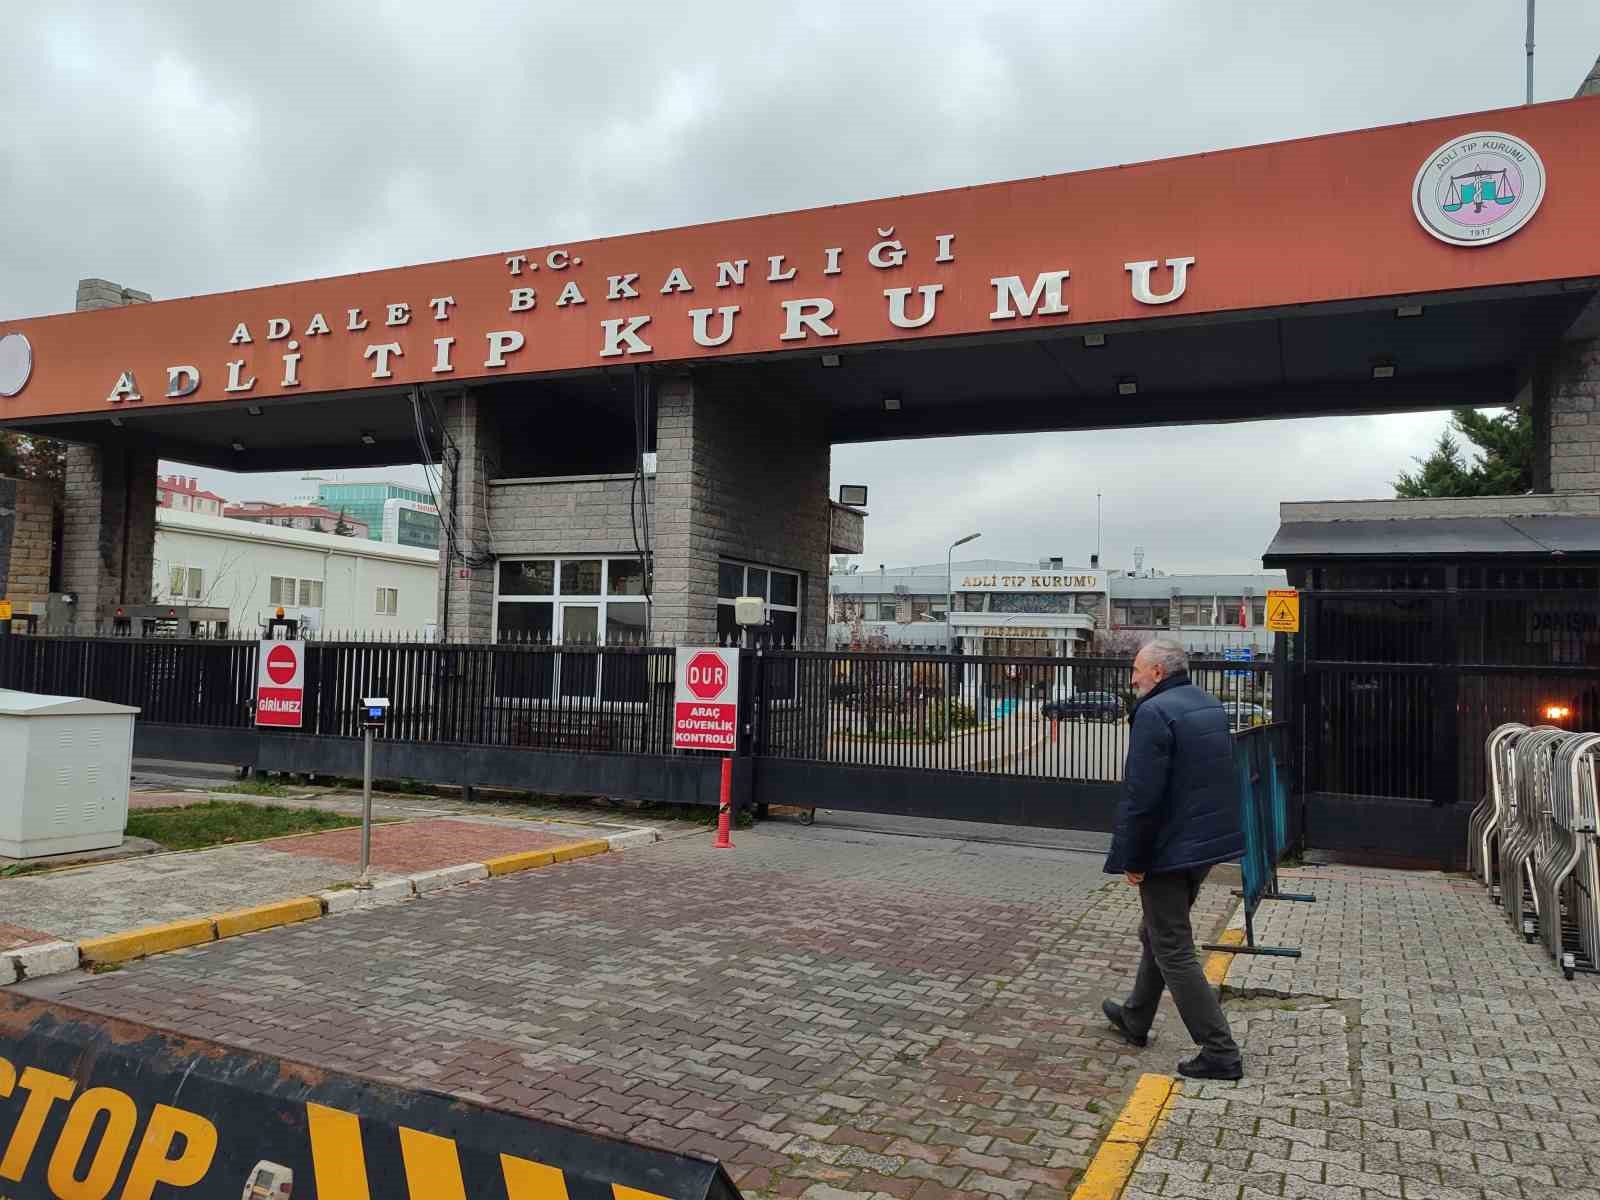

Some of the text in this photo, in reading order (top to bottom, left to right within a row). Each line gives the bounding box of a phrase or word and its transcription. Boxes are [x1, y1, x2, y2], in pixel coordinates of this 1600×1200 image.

[1461, 142, 1478, 153] TIP
[1482, 141, 1526, 163] KURUMU
[506, 248, 582, 276] T.C.
[229, 226, 956, 344] ADALET BAKANLIĞI
[106, 256, 1197, 403] ADLİ TIP KURUMU
[962, 573, 1096, 588] ADLİ TIP KURUMU
[689, 666, 724, 686] DUR
[259, 696, 301, 713] GİRİLMEZ
[690, 706, 721, 719] ARAÇ
[677, 718, 734, 732] GÜVENLİK
[675, 731, 735, 744] KONTROLÜ
